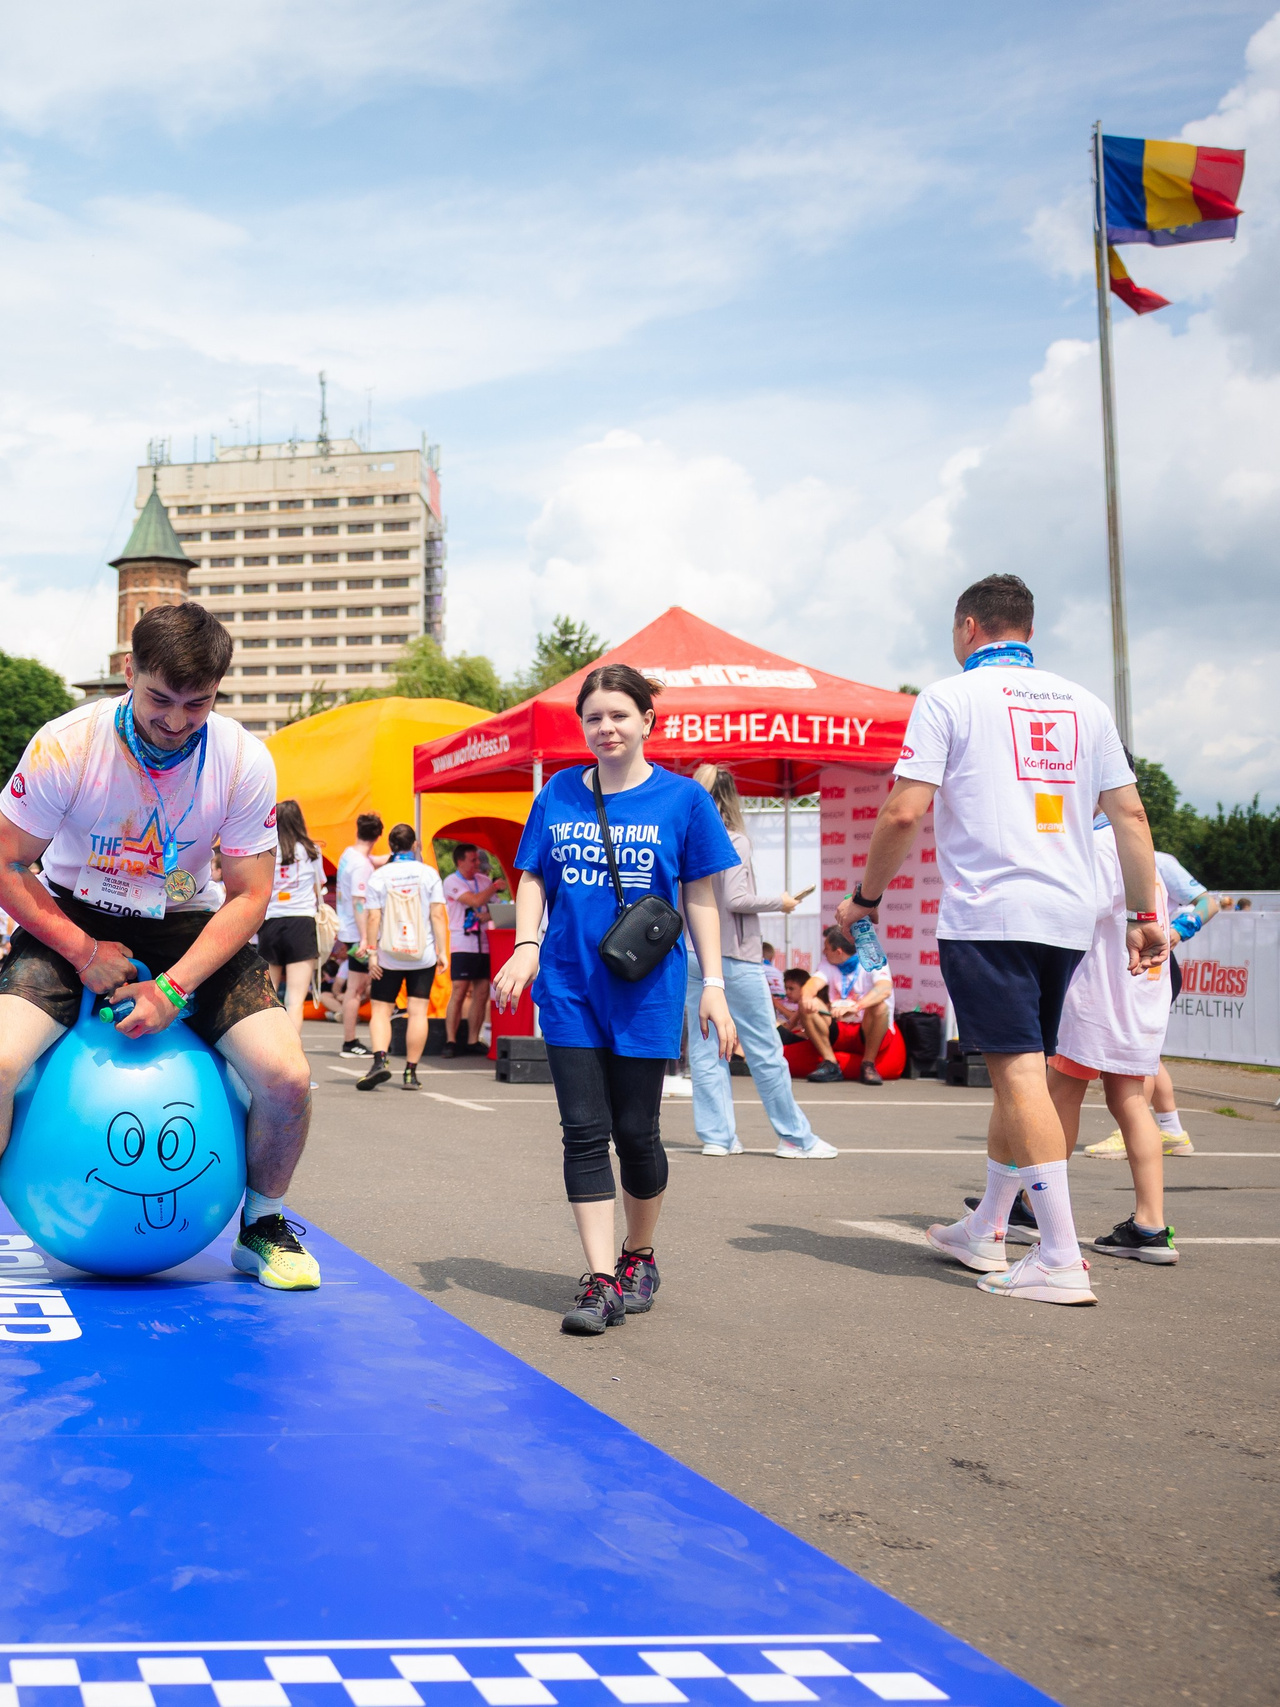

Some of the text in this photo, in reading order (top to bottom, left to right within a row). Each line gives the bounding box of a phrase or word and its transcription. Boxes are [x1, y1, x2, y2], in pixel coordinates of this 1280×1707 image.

[1052, 692, 1073, 701] Bank
[664, 713, 874, 746] #BEHEALTHY
[430, 733, 510, 774] www.worldclass.ro
[1023, 756, 1073, 771] Kafland
[549, 822, 573, 843] THE
[1037, 822, 1065, 833] orang
[90, 833, 123, 857] THE
[551, 843, 655, 871] amazing
[102, 881, 129, 893] amazing
[1199, 961, 1247, 995] Class
[1170, 998, 1244, 1019] HEALTHY
